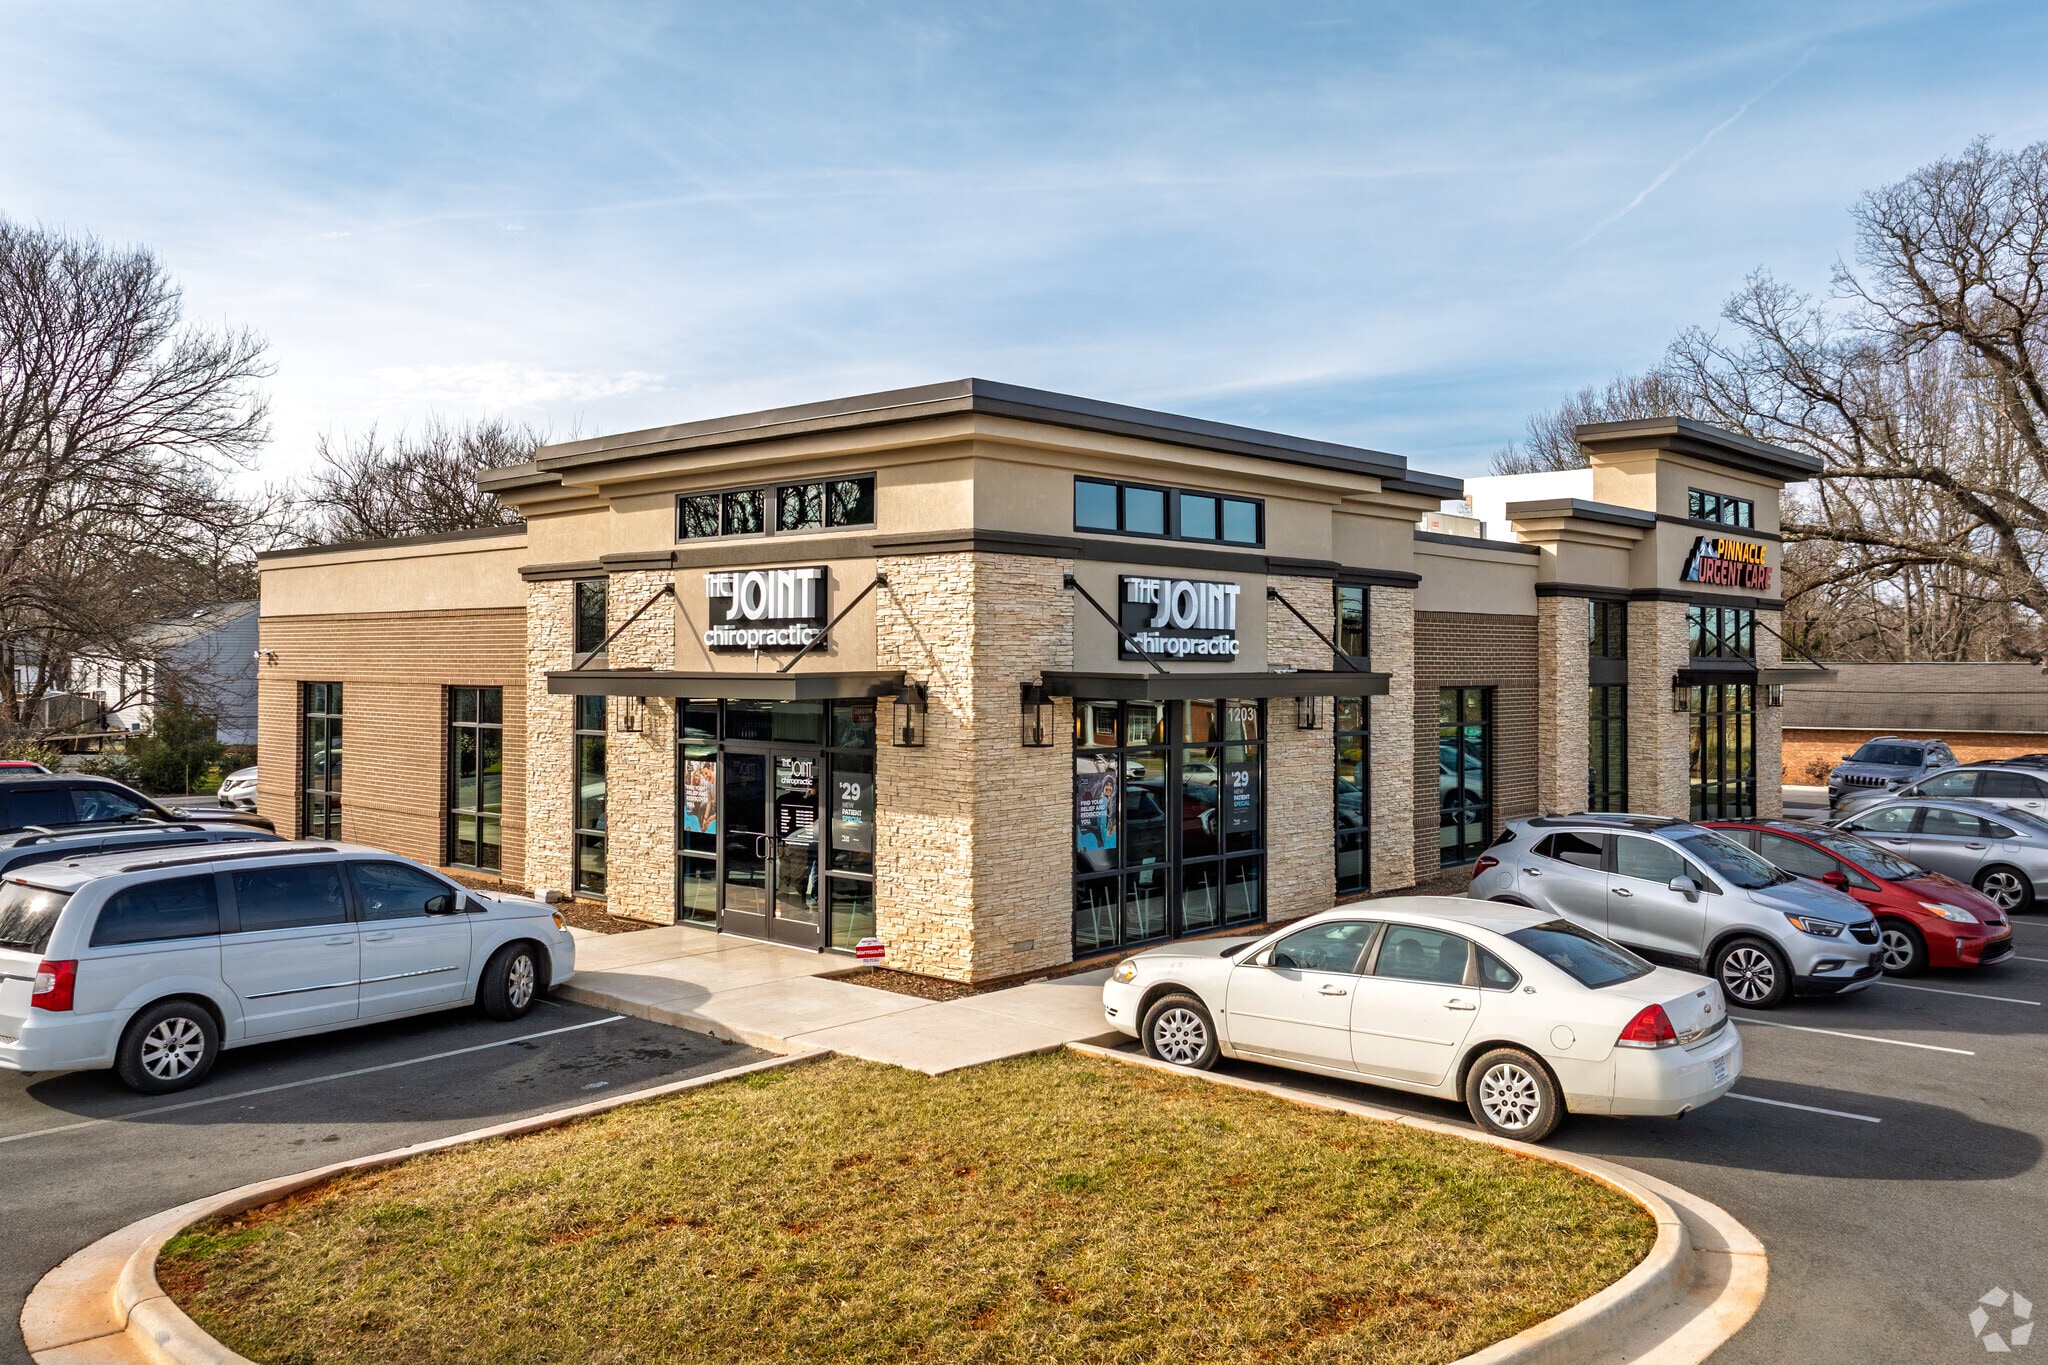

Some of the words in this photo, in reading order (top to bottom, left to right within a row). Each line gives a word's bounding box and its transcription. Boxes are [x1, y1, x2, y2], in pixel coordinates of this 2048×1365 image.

[1717, 538, 1767, 565] PINNACLE
[1698, 557, 1742, 587] URGENT
[1745, 563, 1773, 590] CARE
[703, 573, 734, 598] THE
[726, 568, 821, 621] JOINT
[1124, 577, 1160, 604] THE
[1150, 580, 1241, 631] JOINT
[703, 624, 815, 650] chiropractic
[1124, 631, 1240, 658] chiropractic
[1227, 707, 1254, 722] 1203
[781, 776, 813, 786] chiropractic
[790, 761, 813, 778] JOINT
[841, 808, 863, 817] PATIENT
